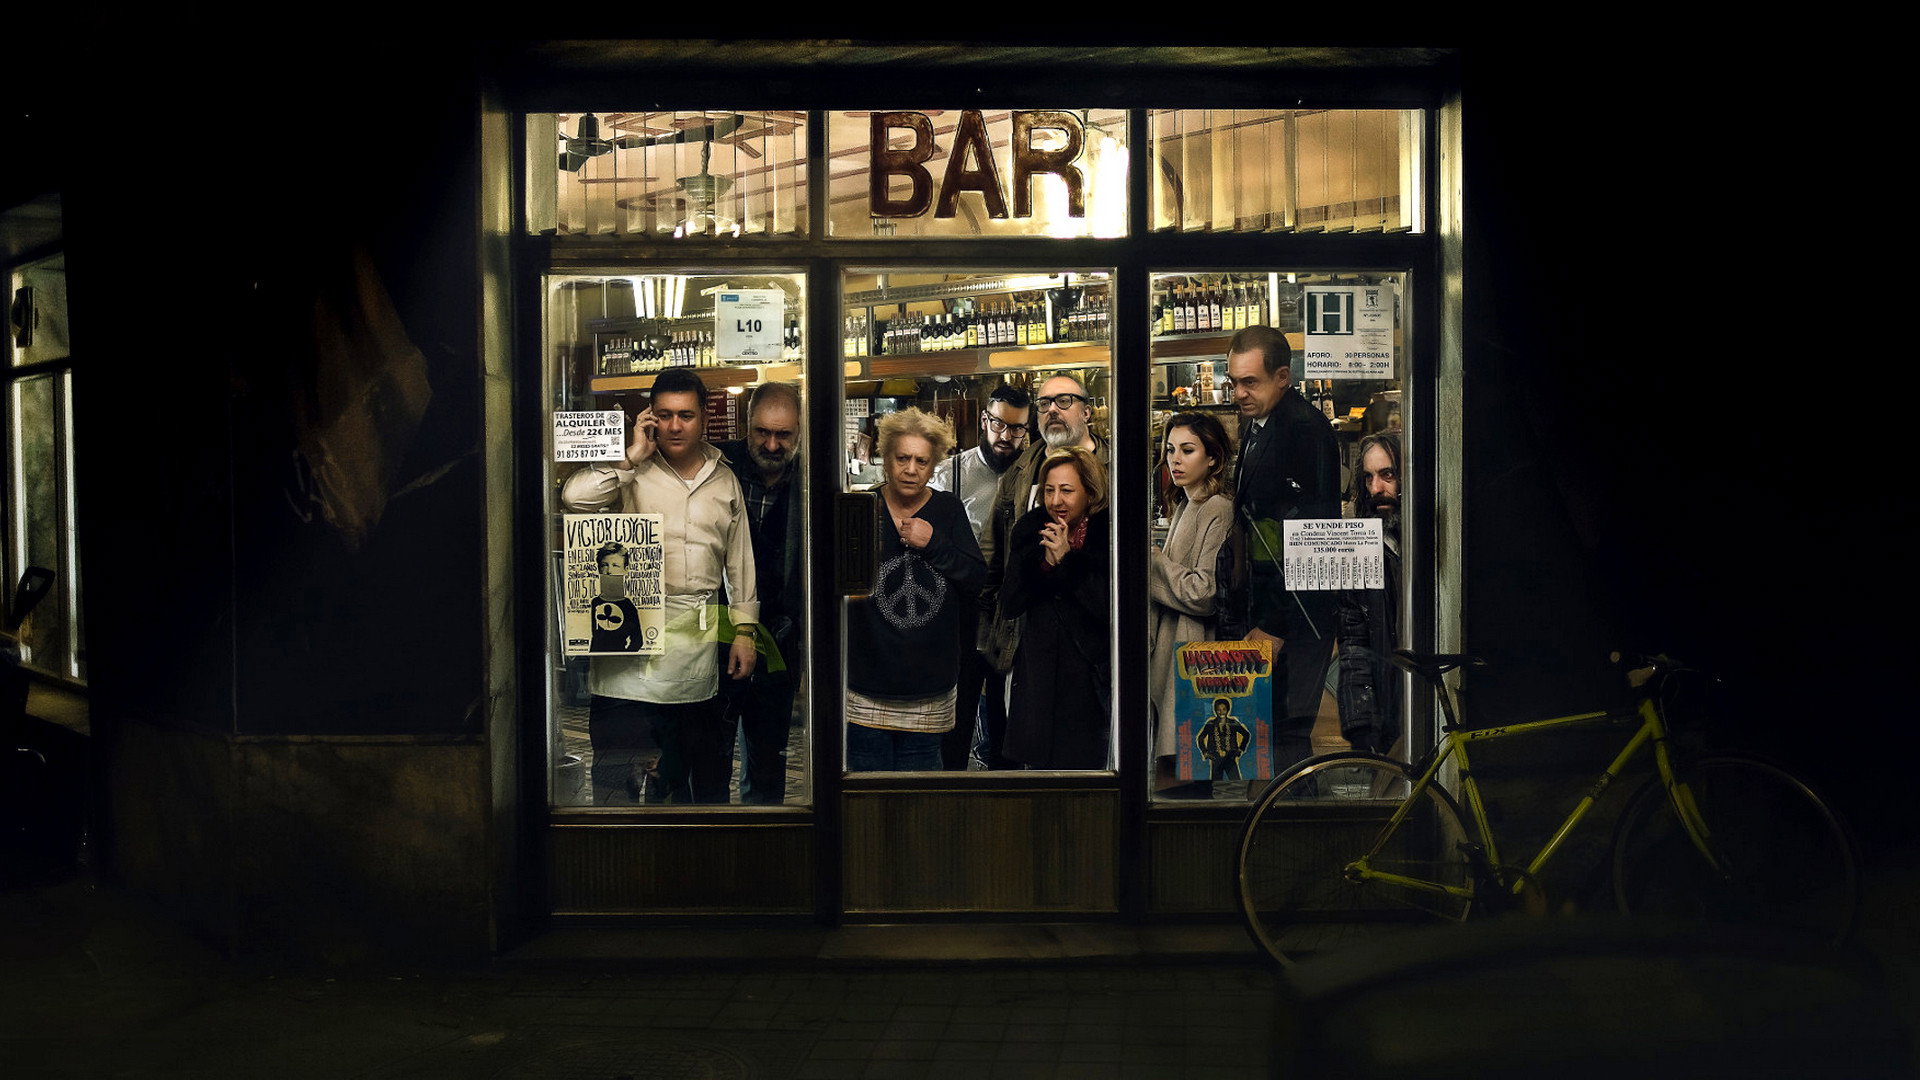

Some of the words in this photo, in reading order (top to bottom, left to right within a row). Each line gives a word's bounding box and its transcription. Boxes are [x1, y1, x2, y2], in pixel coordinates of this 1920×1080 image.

[870, 109, 1085, 219] BAR
[1311, 292, 1352, 334] H
[737, 319, 762, 333] L10
[555, 412, 595, 420] TRASTEROS
[555, 419, 606, 428] ALQUILER
[604, 427, 622, 435] MES
[556, 450, 565, 459] 91
[566, 449, 579, 458] 875
[589, 449, 599, 458] 07
[1345, 521, 1364, 529] PISO
[567, 517, 612, 549] VICTOR
[614, 516, 660, 545] COYOTE
[567, 549, 577, 564] EN
[581, 578, 588, 599] 5
